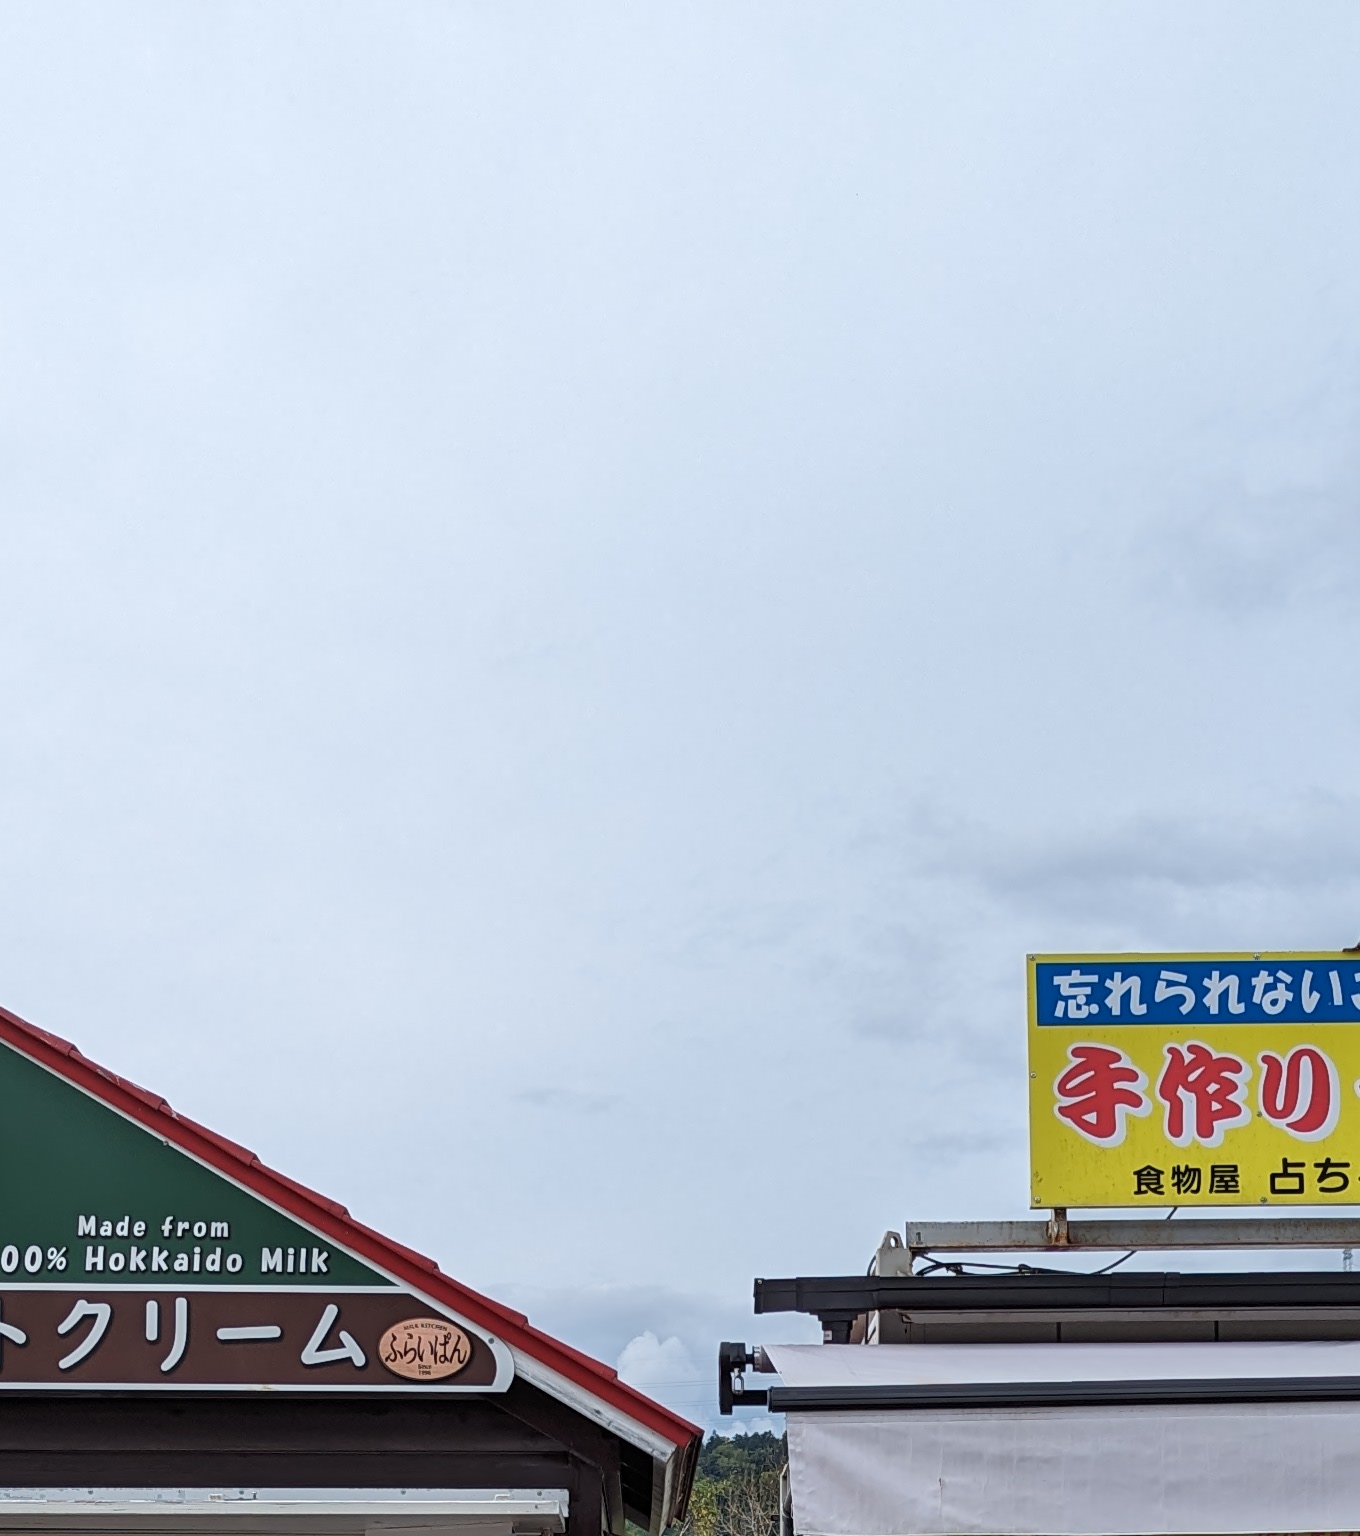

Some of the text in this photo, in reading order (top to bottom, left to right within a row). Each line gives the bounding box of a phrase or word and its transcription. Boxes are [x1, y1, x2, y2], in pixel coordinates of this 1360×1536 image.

[1132, 1165, 1240, 1196] 食物屋
[77, 1214, 230, 1238] Made from
[85, 1245, 243, 1273] Hokkaido
[260, 1247, 330, 1274] Milk
[384, 1332, 468, 1365] ふらいぱん
